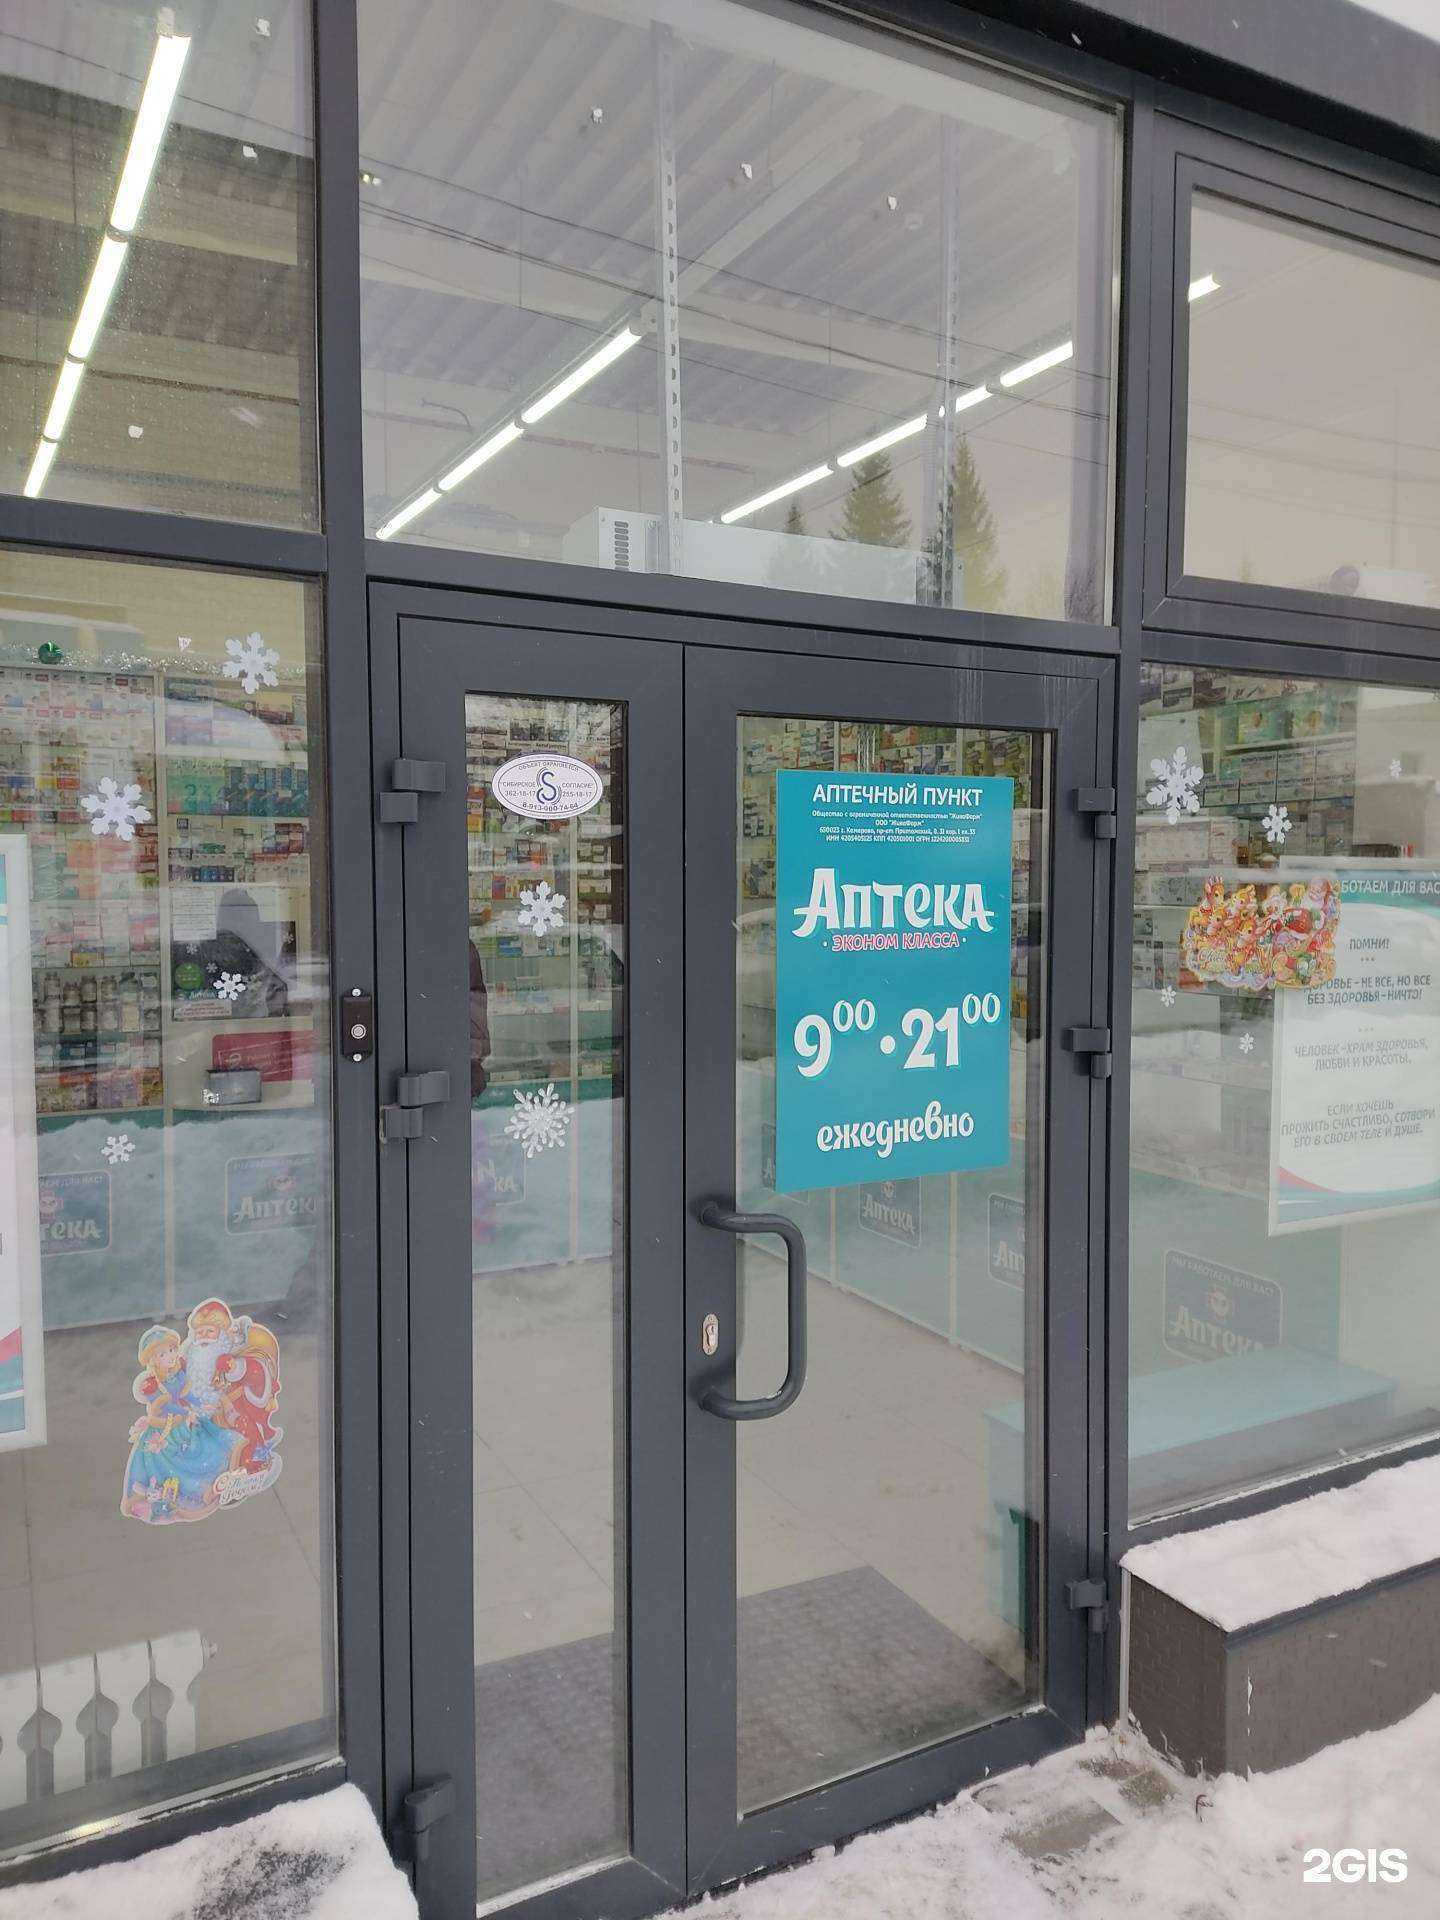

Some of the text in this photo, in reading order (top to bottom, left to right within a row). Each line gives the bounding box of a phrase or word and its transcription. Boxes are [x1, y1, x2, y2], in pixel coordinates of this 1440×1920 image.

[812, 782, 983, 807] АПТЕЧНЫЙ ПУНКТ
[812, 810, 843, 818] Общество
[849, 810, 889, 820] ограниченной
[890, 812, 948, 820] ответственностью
[846, 827, 876, 835] Кемерово,
[1341, 880, 1390, 894] БОТАЕМ
[1392, 880, 1417, 896] ДЛЯ
[832, 932, 960, 951] ЭКОНОМ КЛАССА
[1349, 938, 1390, 950] ПОМНИ!
[1397, 975, 1411, 986] НО
[1413, 974, 1432, 986] ВСЕ
[1307, 993, 1326, 1006] БЕЗ
[1314, 1057, 1352, 1071] ЛЮБВИ
[1327, 1098, 1395, 1117] ЕСЛИ ХОЧЕШЬ
[816, 1100, 975, 1158] ежедневно
[1281, 1108, 1436, 1136] ПРОЖИТЬ СЧАСТЛИВО, СОТВОРИ
[1294, 1135, 1312, 1149] ЕГО
[1323, 1131, 1357, 1146] СВОЕМ
[1359, 1127, 1382, 1141] ТЕЛЕ
